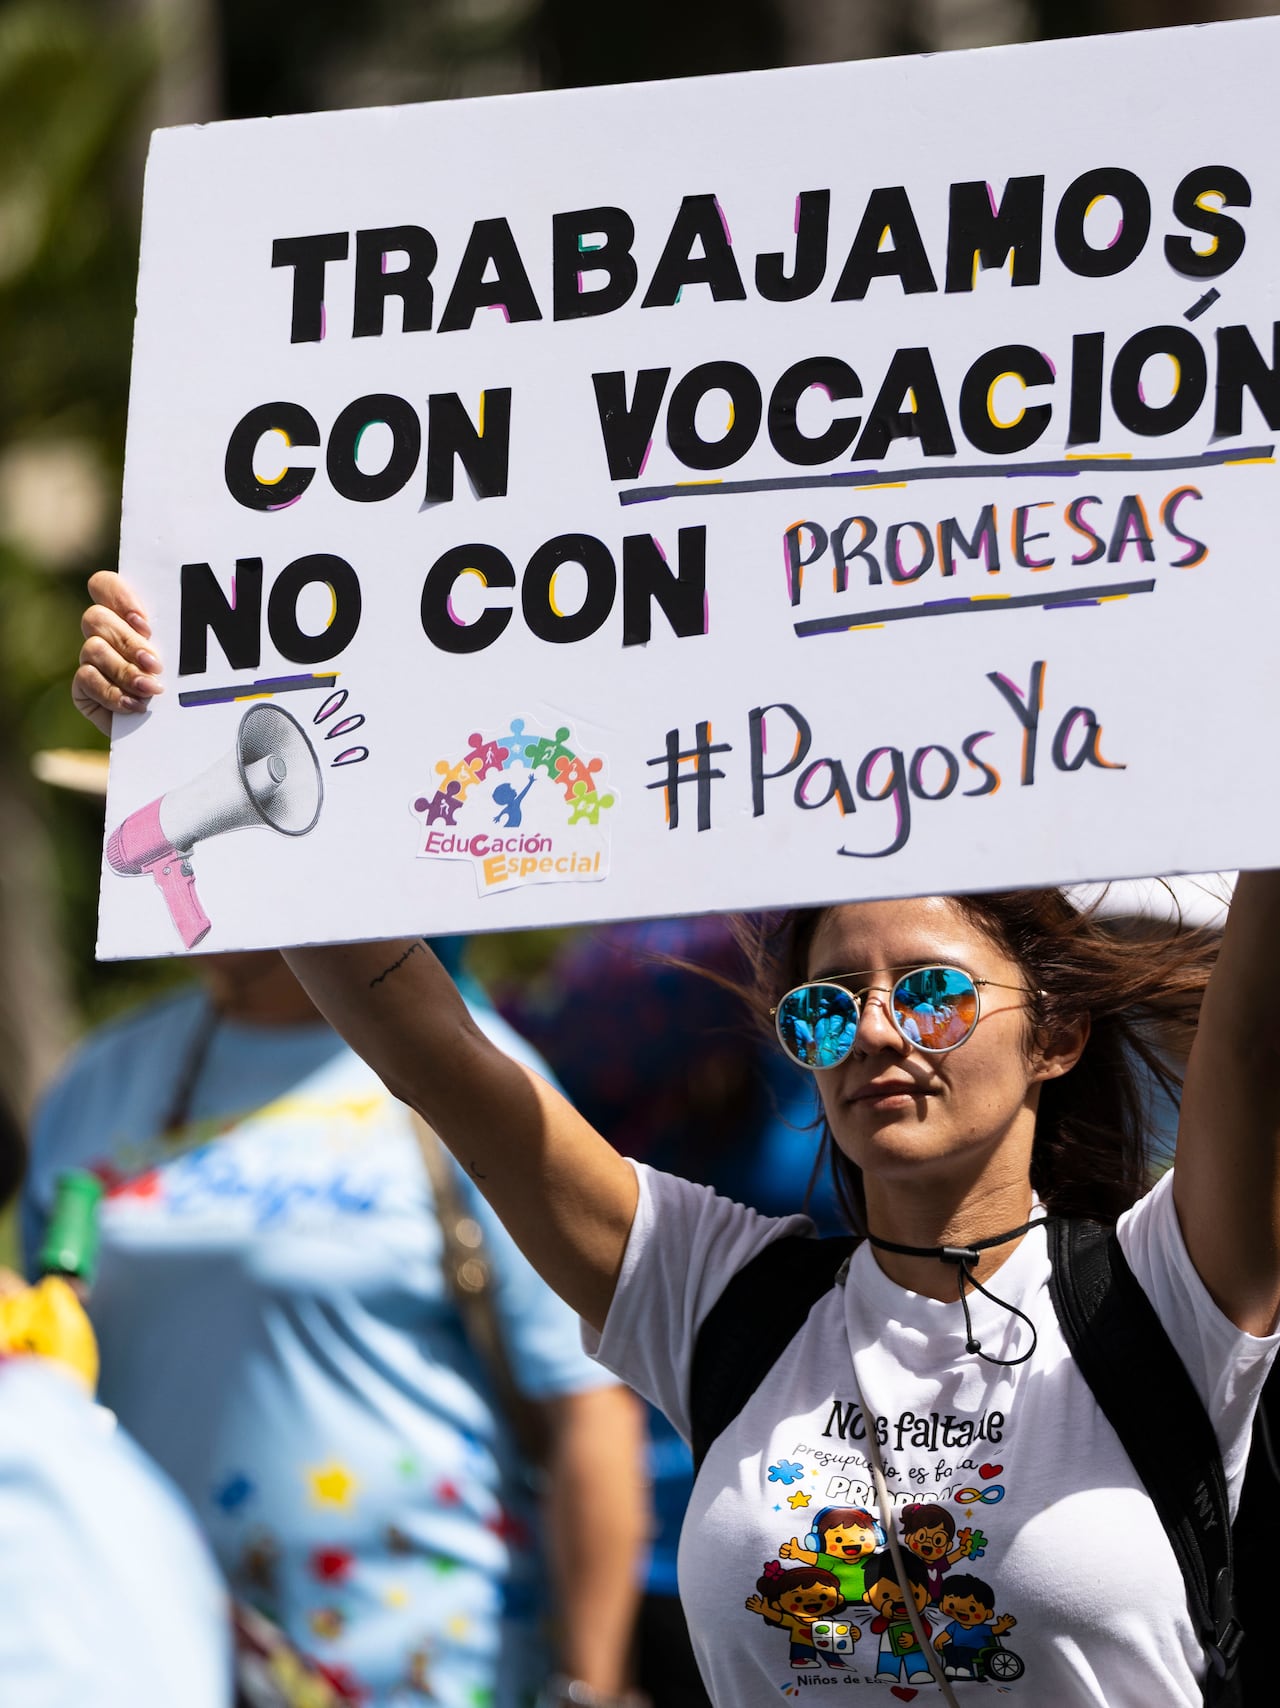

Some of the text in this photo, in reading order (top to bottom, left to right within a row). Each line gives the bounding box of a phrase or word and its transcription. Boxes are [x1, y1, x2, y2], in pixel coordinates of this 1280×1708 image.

[271, 165, 1252, 344] TRABAJAMOS
[224, 387, 512, 511] CON
[179, 484, 1210, 676] NO CON PROMESAS
[645, 660, 1127, 859] #PagosYa
[483, 852, 601, 886] Especial
[792, 1443, 978, 1484] presupueto, es faa
[893, 1411, 974, 1452] falta
[797, 1674, 838, 1687] Niños
[843, 1674, 861, 1685] de
